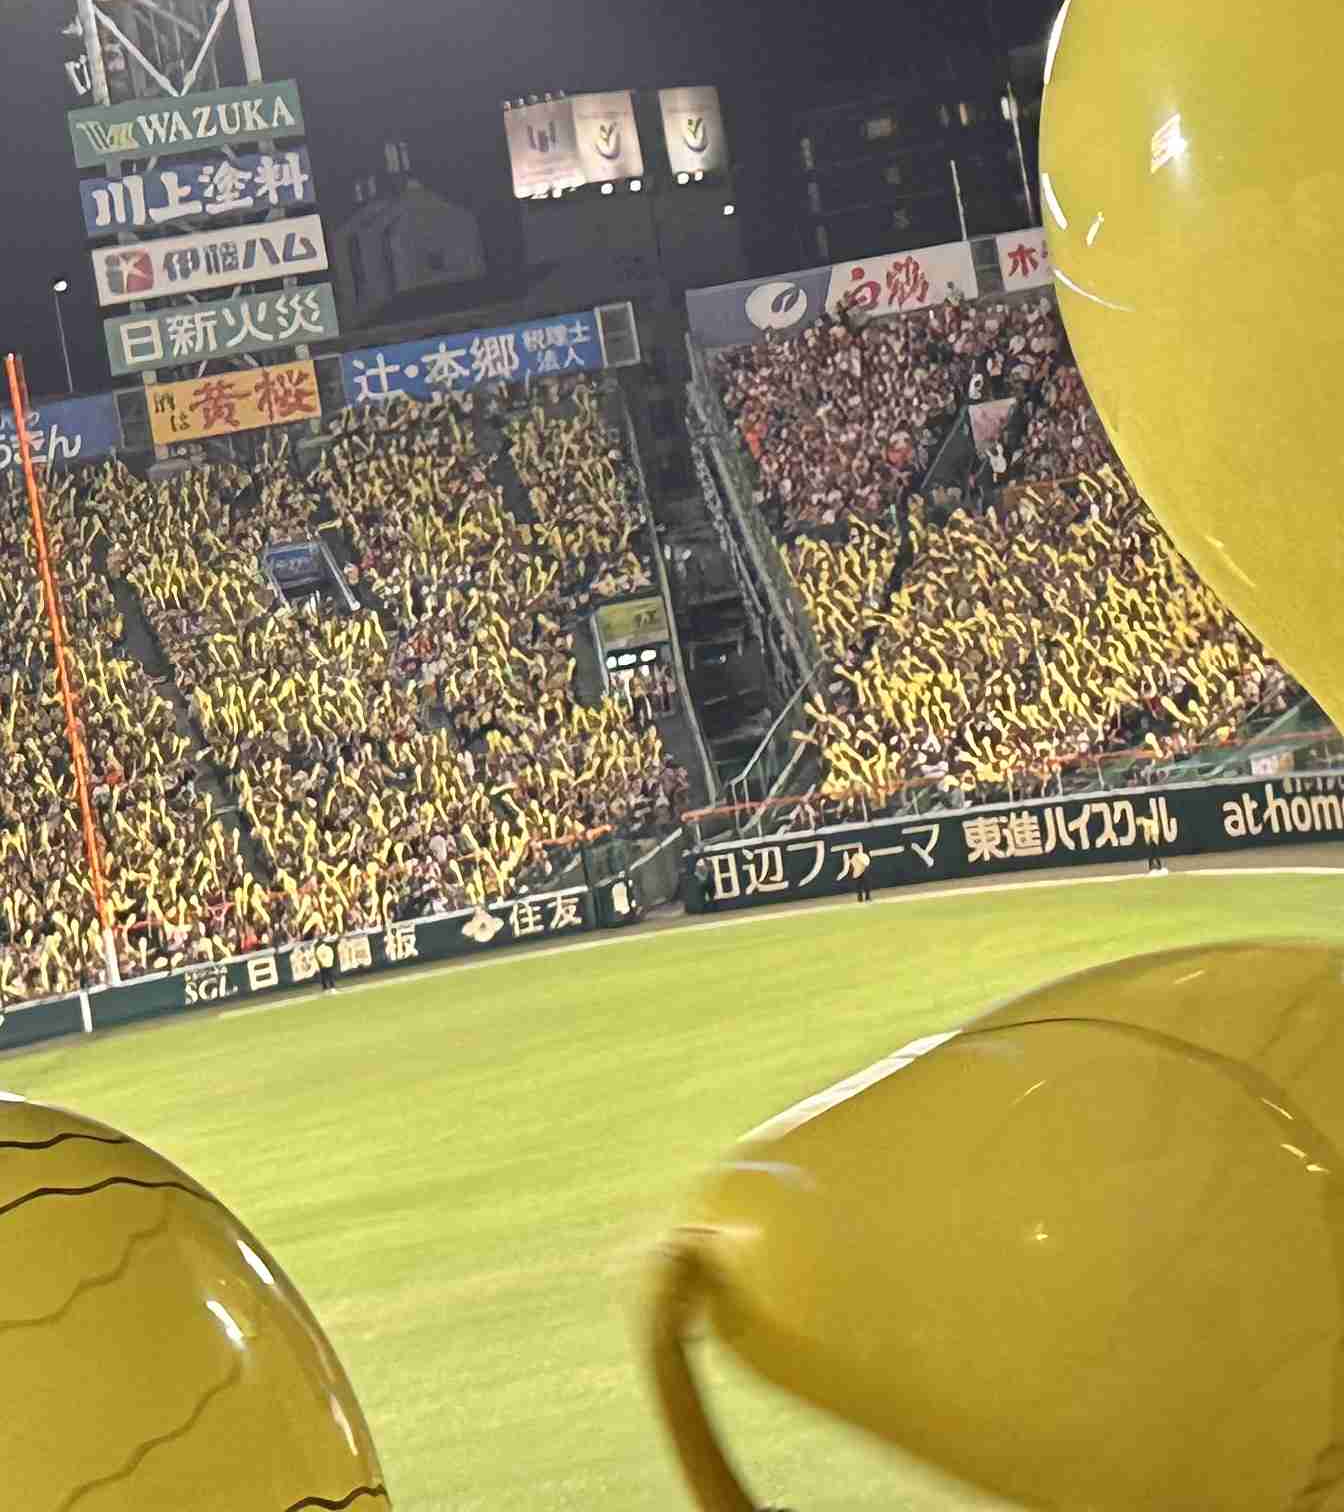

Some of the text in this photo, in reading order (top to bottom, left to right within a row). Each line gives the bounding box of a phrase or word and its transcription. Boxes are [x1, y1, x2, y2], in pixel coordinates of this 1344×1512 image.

[136, 95, 296, 145] WAZUKA
[91, 151, 310, 226] 川上塗料
[119, 290, 324, 365] 日新火災
[353, 333, 519, 402] 辻・本郷
[510, 895, 583, 938] 住友
